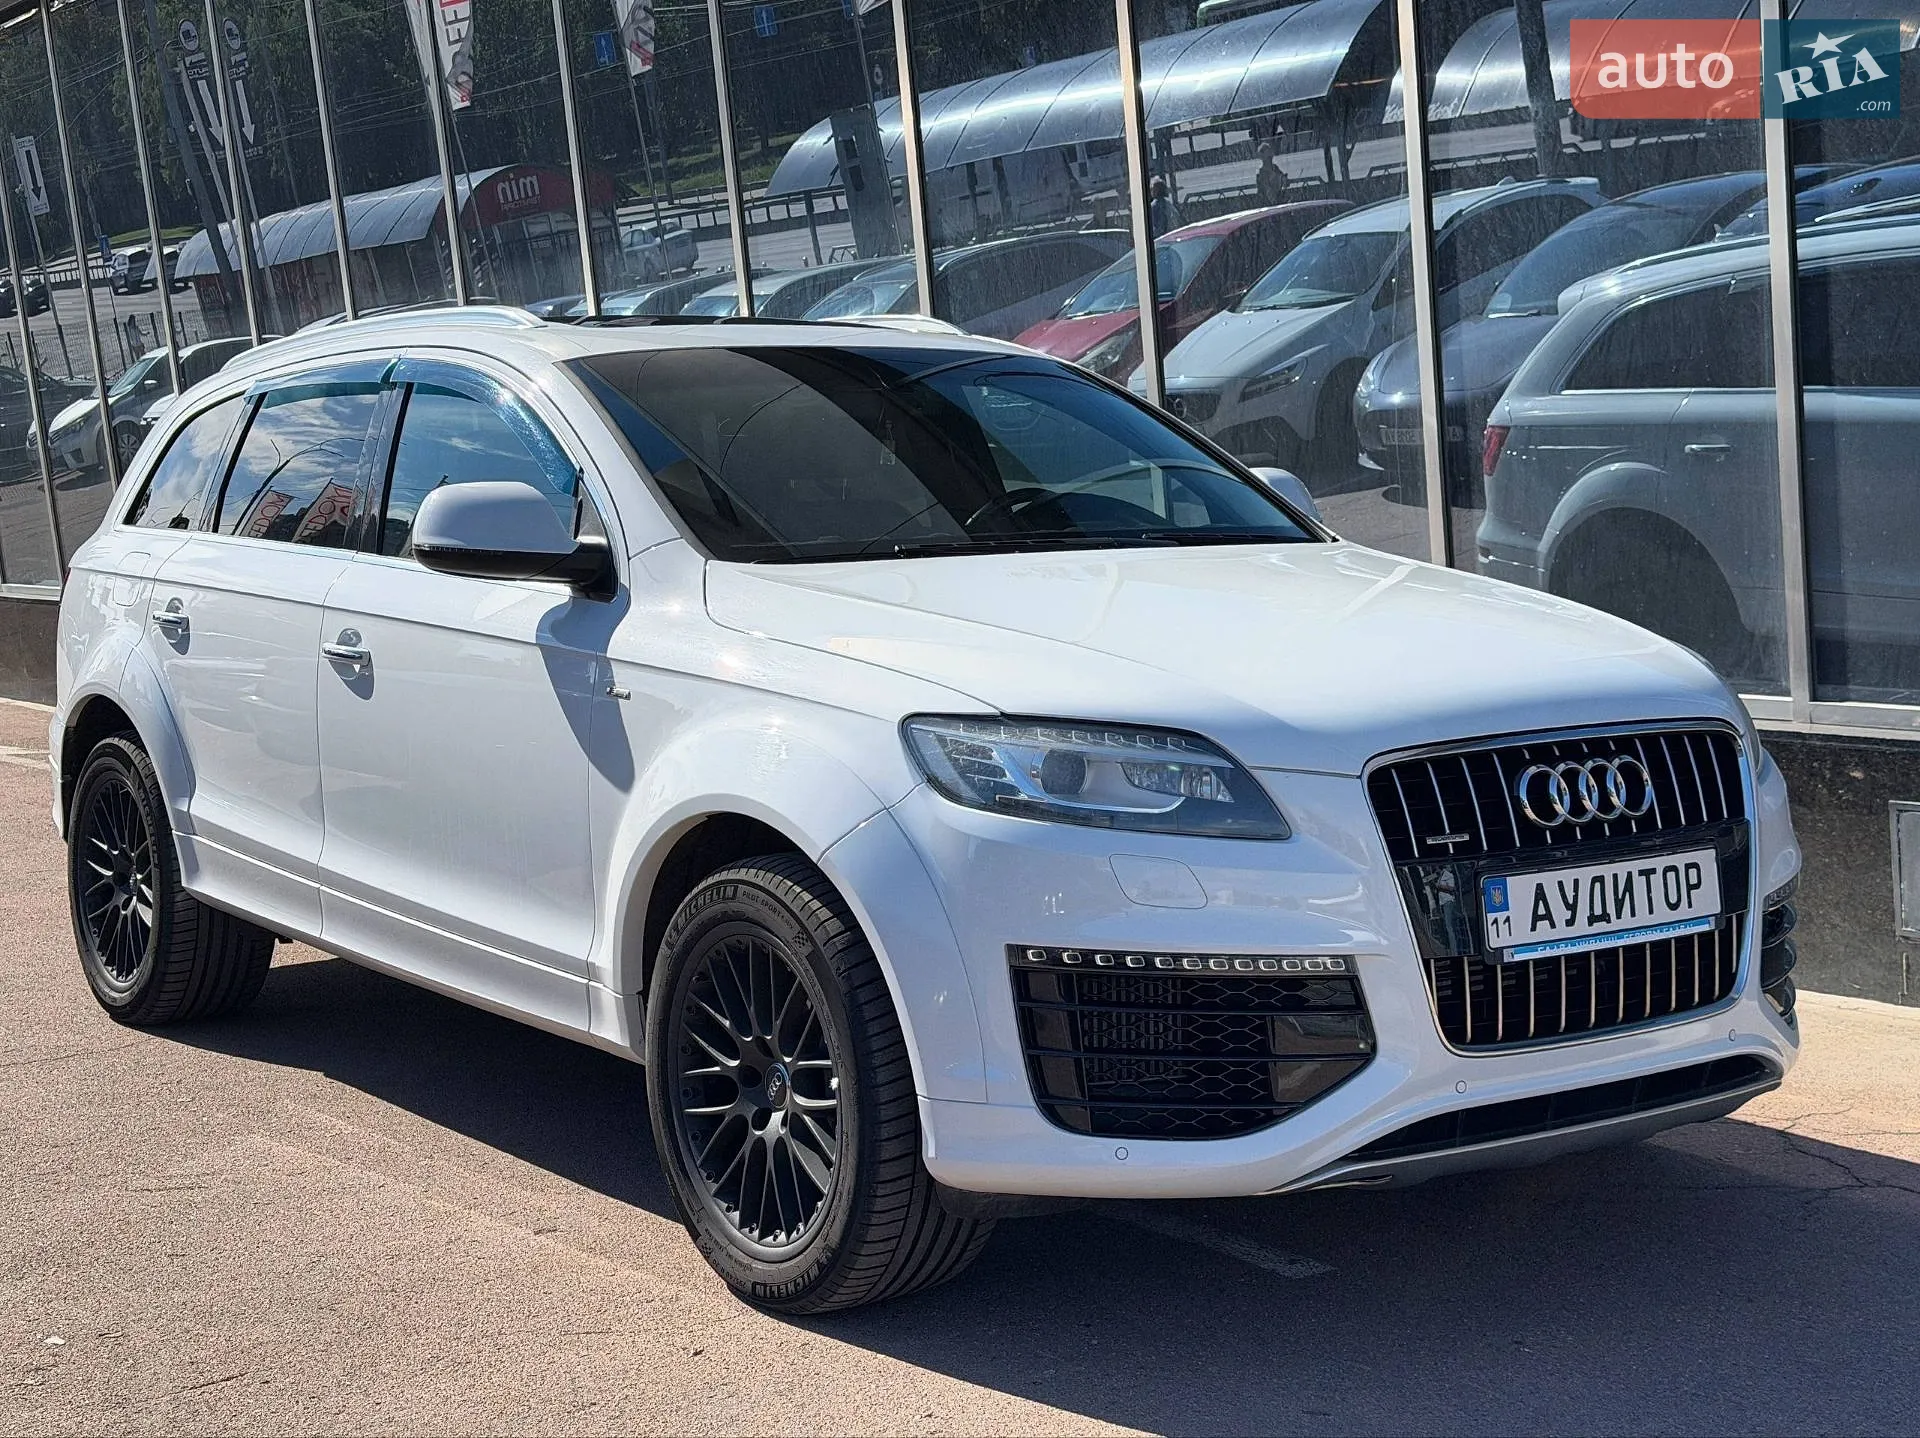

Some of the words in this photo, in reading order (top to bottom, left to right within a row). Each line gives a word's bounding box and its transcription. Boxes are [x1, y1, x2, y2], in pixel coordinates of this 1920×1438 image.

[677, 885, 735, 930] MICHELIN
[1490, 916, 1512, 938] 11
[1530, 862, 1702, 932] АУДИТОР
[755, 1263, 820, 1298] MICHELIN
